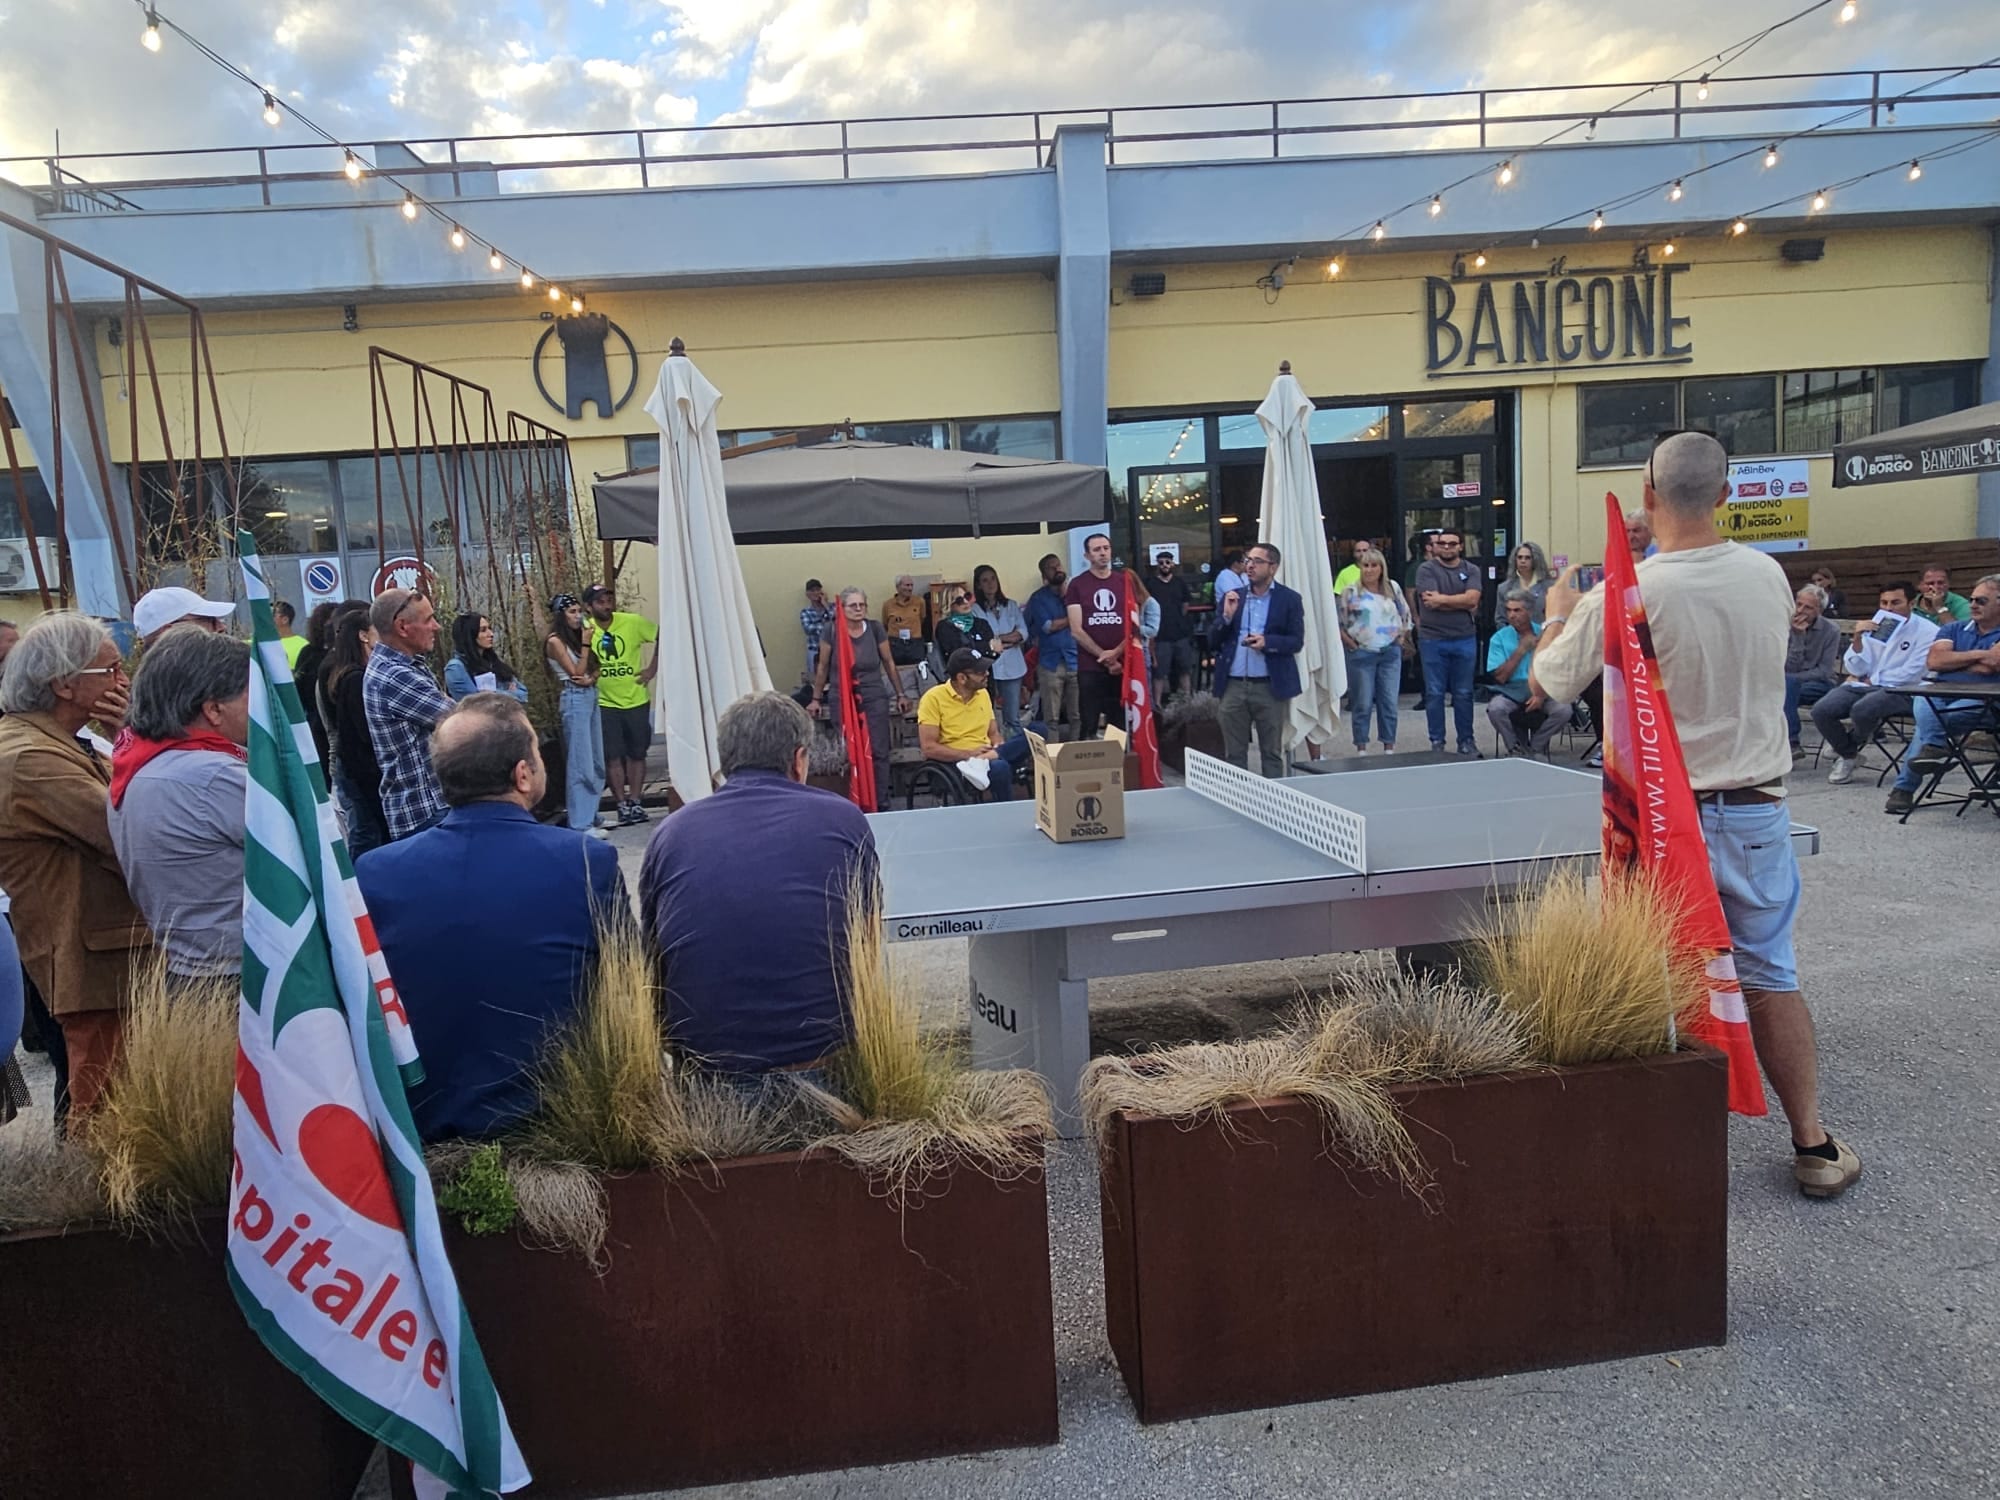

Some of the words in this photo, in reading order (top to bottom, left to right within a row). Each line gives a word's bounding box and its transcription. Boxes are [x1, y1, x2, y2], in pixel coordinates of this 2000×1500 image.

[1425, 264, 1693, 370] BANCONE
[1921, 443, 1980, 472] BANCONE
[1737, 465, 1776, 475] ABInBev
[1869, 459, 1914, 475] BORGO
[1728, 500, 1782, 511] CHIUDONO
[1748, 518, 1782, 527] BORGO
[1760, 530, 1806, 540] DIPENDENTI
[1088, 616, 1122, 625] BORGO
[601, 667, 633, 678] ORGO
[1070, 826, 1108, 837] BORGO
[897, 919, 983, 939] Cornilleau
